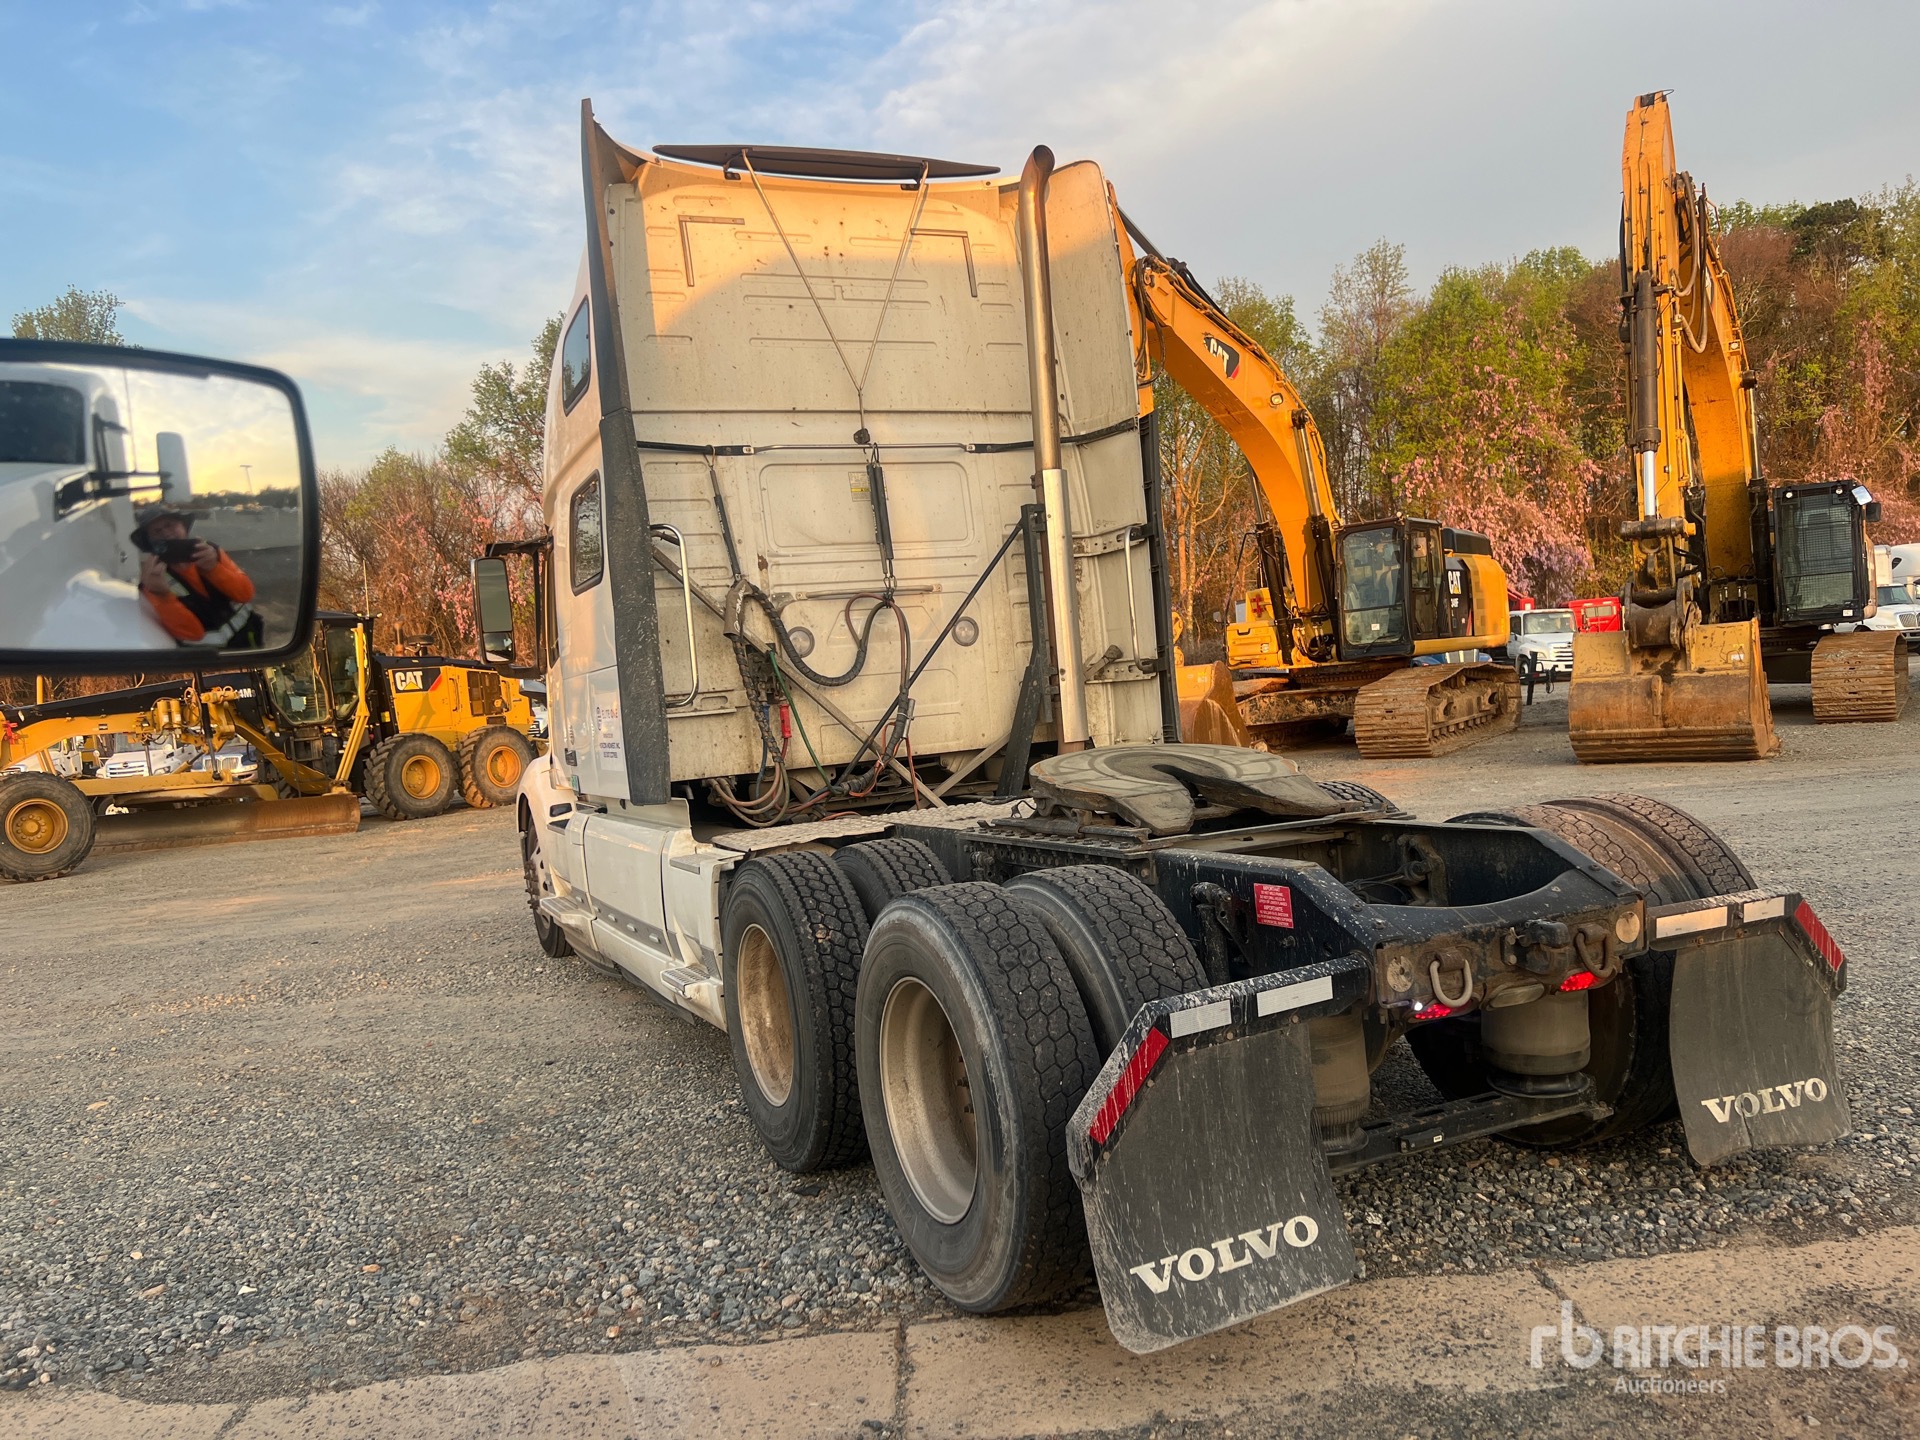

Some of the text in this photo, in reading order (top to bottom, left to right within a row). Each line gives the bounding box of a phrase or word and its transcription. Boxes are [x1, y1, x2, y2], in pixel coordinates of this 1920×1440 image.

[1209, 337, 1229, 373] CAT
[1448, 570, 1462, 595] CAT
[395, 670, 423, 690] CAT
[1699, 1077, 1829, 1124] VOLVO
[1128, 1214, 1320, 1295] VOLVO
